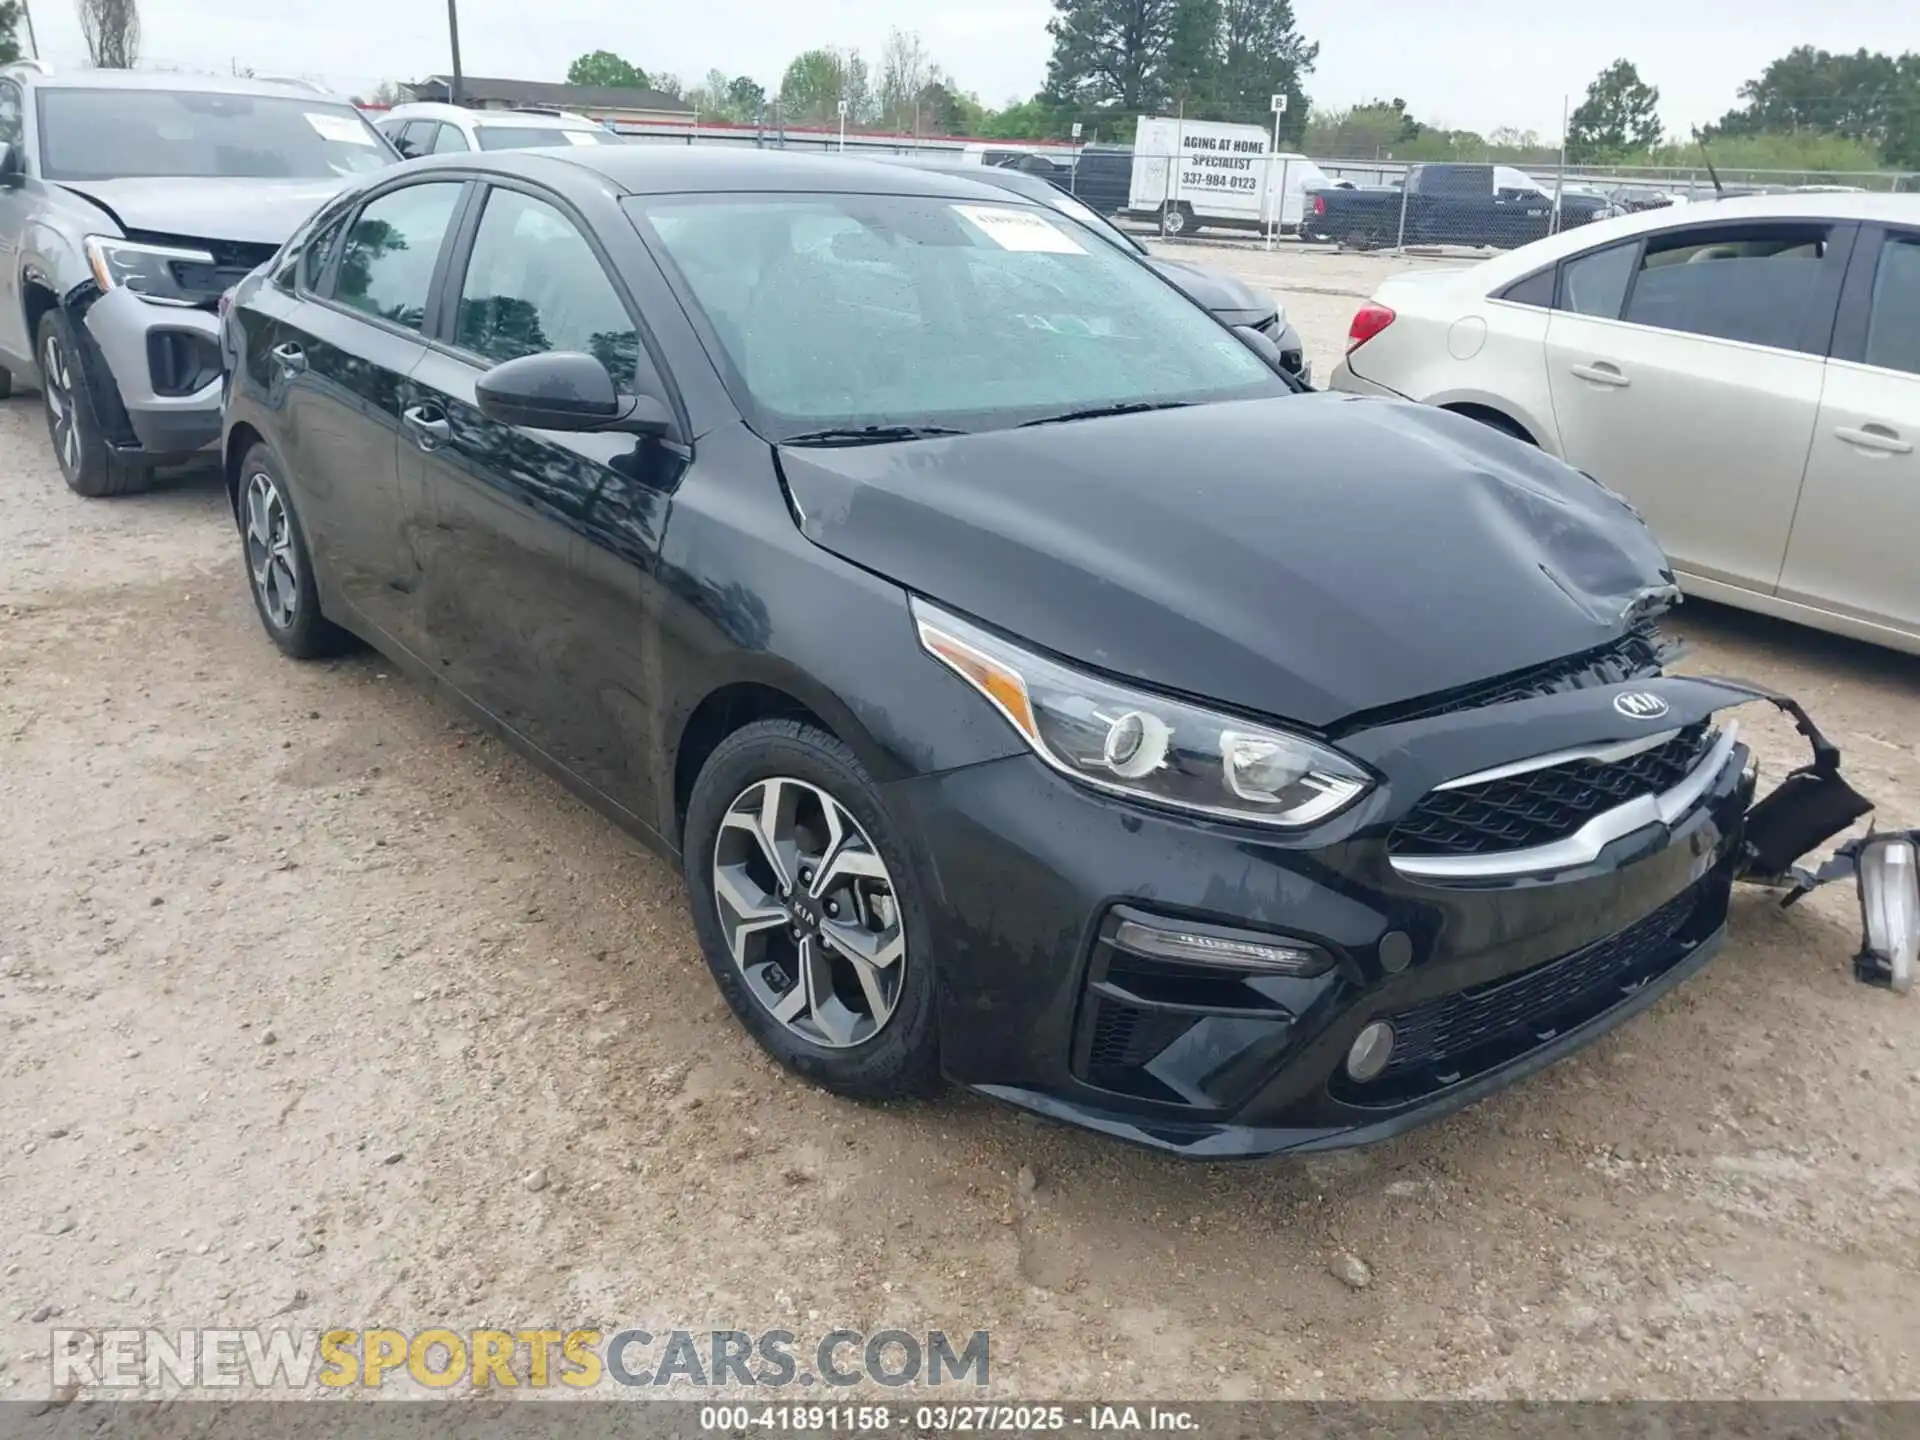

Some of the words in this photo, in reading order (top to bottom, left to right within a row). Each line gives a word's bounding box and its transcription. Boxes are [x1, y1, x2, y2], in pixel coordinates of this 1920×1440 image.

[1183, 136, 1216, 150] AGING
[1218, 139, 1232, 151] AT
[1233, 140, 1264, 154] HOME
[1192, 154, 1252, 170] SPECIALIST
[1619, 692, 1666, 714] KIA
[793, 901, 815, 925] KIA
